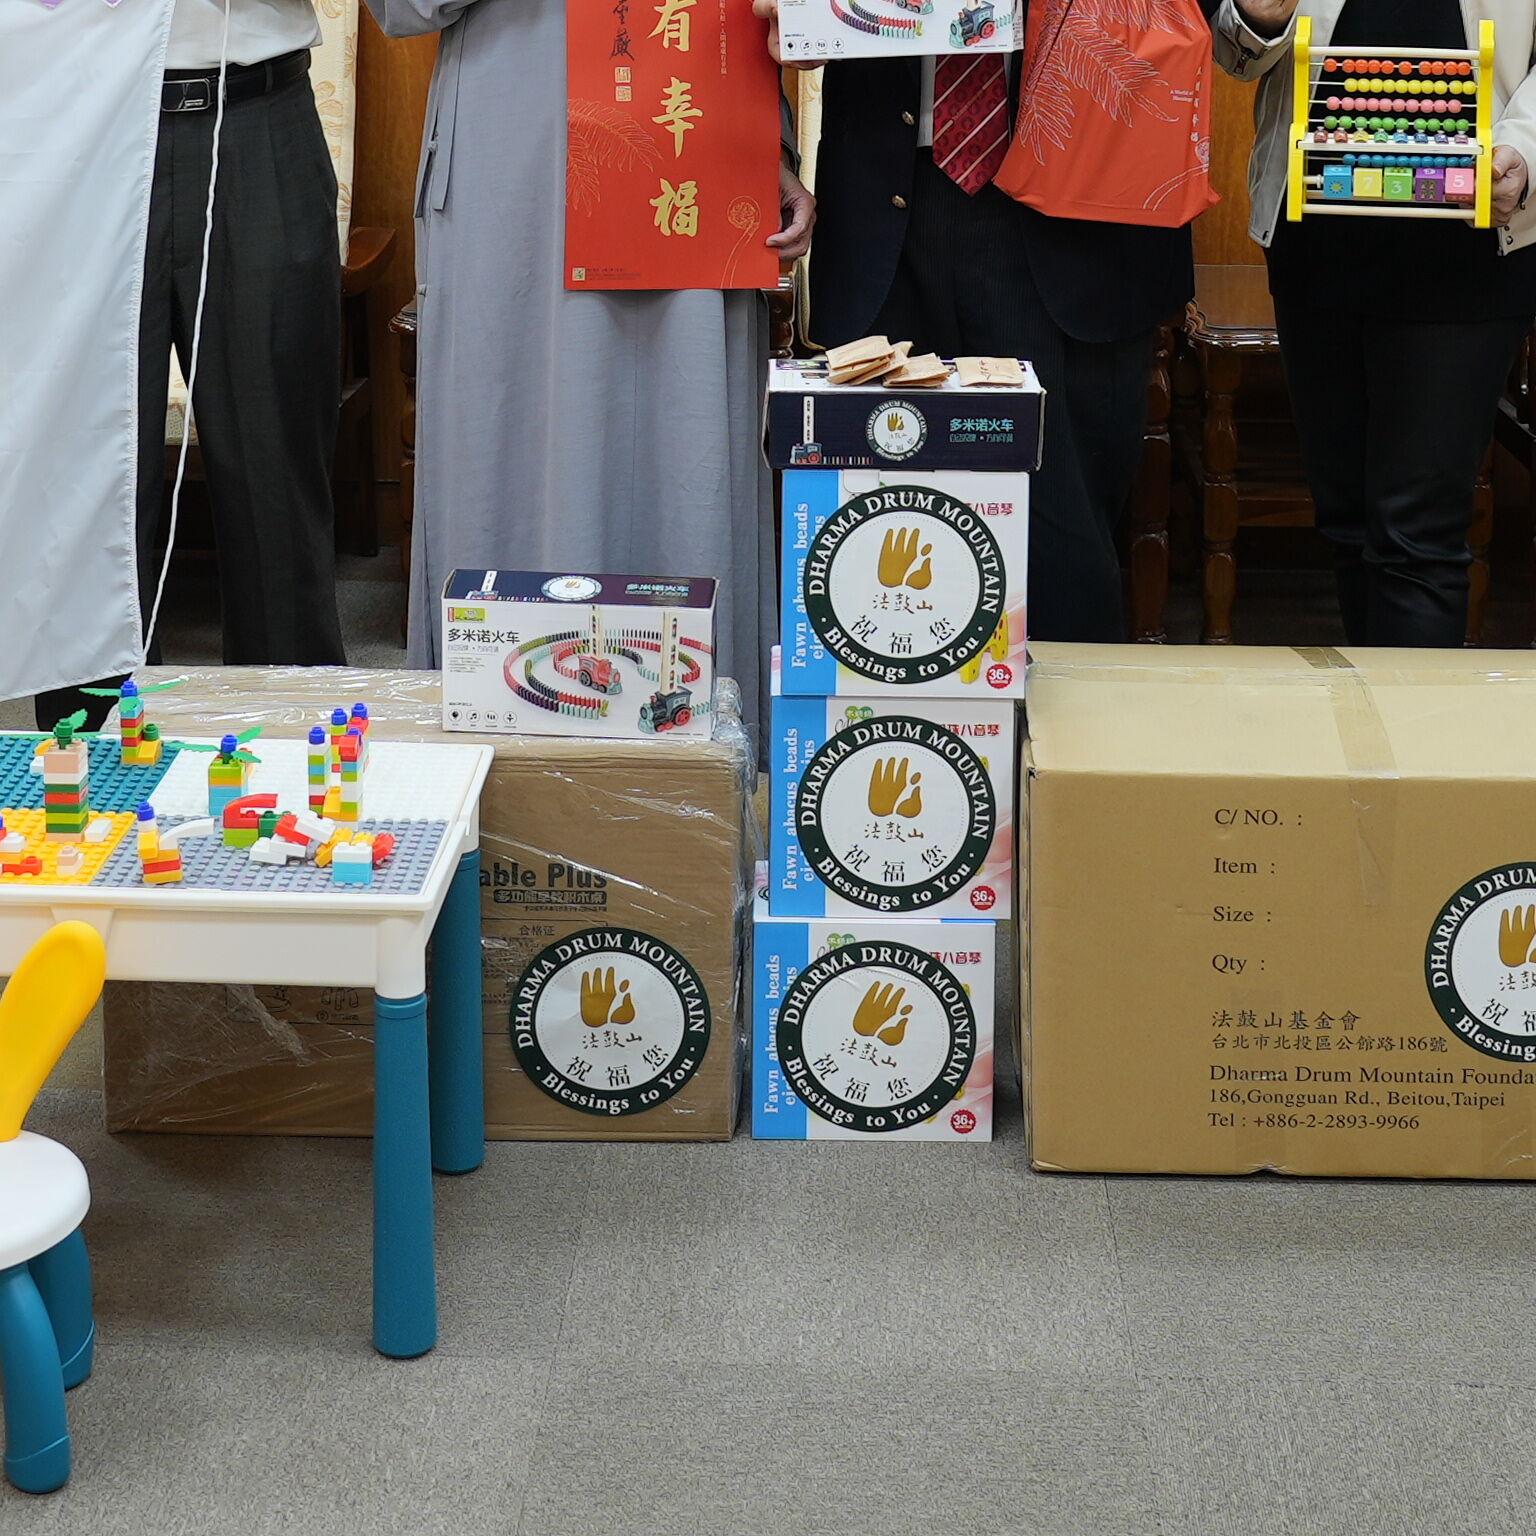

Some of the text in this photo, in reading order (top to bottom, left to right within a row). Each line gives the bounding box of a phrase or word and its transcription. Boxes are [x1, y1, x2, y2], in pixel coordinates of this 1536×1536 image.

[1391, 181, 1403, 193] 3
[1453, 175, 1465, 188] 5
[949, 418, 1014, 432] 多米诺火车
[792, 503, 809, 549] beads
[809, 489, 1001, 614] DHARMA DRUM MOUNTAIN
[873, 593, 933, 614] 法鼓山
[448, 628, 521, 644] 多米诺火车
[792, 622, 807, 668] Fawn
[850, 613, 956, 655] 祝福您
[823, 626, 907, 682] Blessings
[918, 663, 939, 677] to
[939, 634, 980, 666] You
[800, 719, 990, 841] DHARMA DRUM MOUNTAIN
[782, 727, 798, 890] Fawn abacus beads
[1243, 810, 1284, 826] NO.
[865, 821, 924, 843] 法鼓山
[548, 864, 607, 888] Plus
[842, 843, 947, 884] 祝福您
[1214, 858, 1257, 875] Item
[817, 855, 901, 911] Blessings
[911, 889, 933, 905] to
[933, 862, 971, 896] You
[1212, 906, 1254, 922] Size
[520, 925, 556, 936] 合格证
[1430, 895, 1476, 988] DHARMA
[765, 955, 780, 999] beads
[1211, 954, 1247, 974] Qty
[515, 958, 556, 1048] DHARMA
[556, 933, 623, 962] DRUM
[630, 936, 705, 1034] MOUNTAIN
[782, 945, 973, 1088] DHARMA DRUM MOUNTAIN
[1211, 1010, 1361, 1031] 法鼓山基金會
[583, 1030, 642, 1049] 法鼓山
[840, 1037, 898, 1069] 法鼓山
[1211, 1033, 1449, 1053] 台北市北投區公館路186號
[566, 1044, 669, 1087] 祝福您
[813, 1052, 913, 1102] 祝福您
[1210, 1064, 1288, 1082] Dharma
[1295, 1065, 1352, 1083] Drum
[1359, 1066, 1454, 1084] Mountain
[541, 1057, 695, 1115] Blessings to You
[764, 1070, 779, 1113] Fawn
[786, 1057, 855, 1125] Blessings
[866, 1111, 886, 1127] to
[885, 1102, 931, 1127] You
[1210, 1088, 1506, 1109] 186,Gongguan Rd., Beitou,Taipei
[1208, 1112, 1235, 1128] Tel
[1252, 1113, 1420, 1131] +886-2-2893-9966
